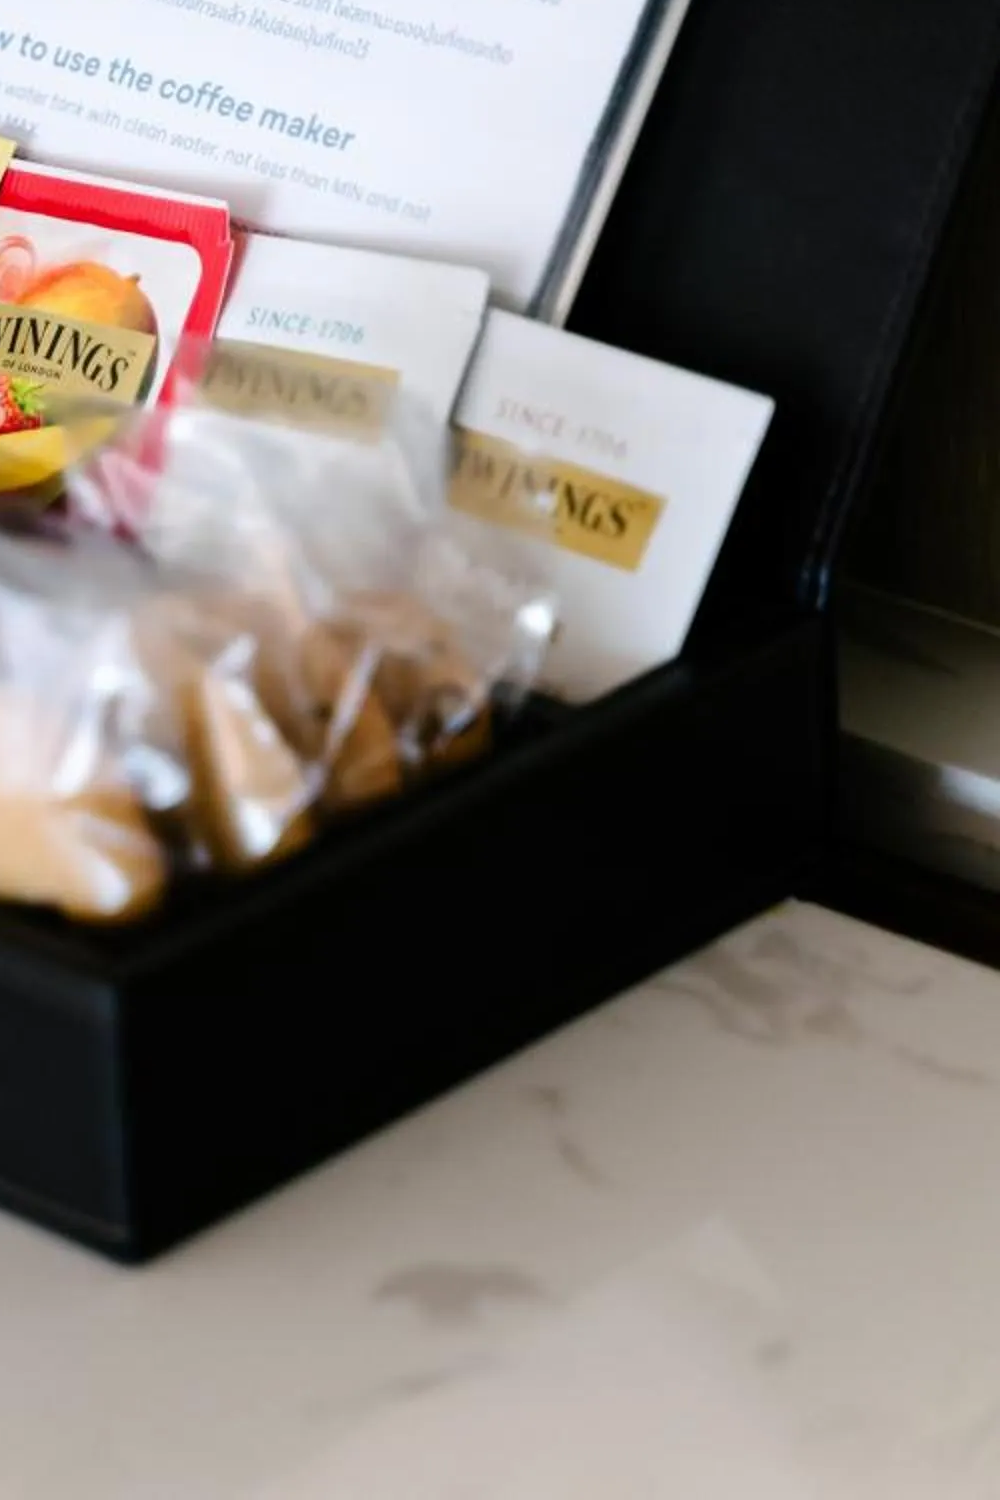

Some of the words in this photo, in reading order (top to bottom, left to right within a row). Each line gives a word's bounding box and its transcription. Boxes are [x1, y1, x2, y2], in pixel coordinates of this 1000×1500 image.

[2, 113, 41, 138] MAX
[18, 32, 49, 62] to
[53, 46, 102, 77] use
[107, 58, 154, 93] the
[158, 78, 255, 123] coffee
[257, 107, 357, 151] maker
[50, 92, 83, 117] tank
[85, 106, 122, 131] with
[122, 116, 168, 145] clean
[170, 132, 219, 161] water,
[222, 147, 252, 169] not
[253, 153, 288, 180] less
[289, 165, 330, 193] than
[365, 190, 402, 214] and
[17, 361, 62, 380] LONDON
